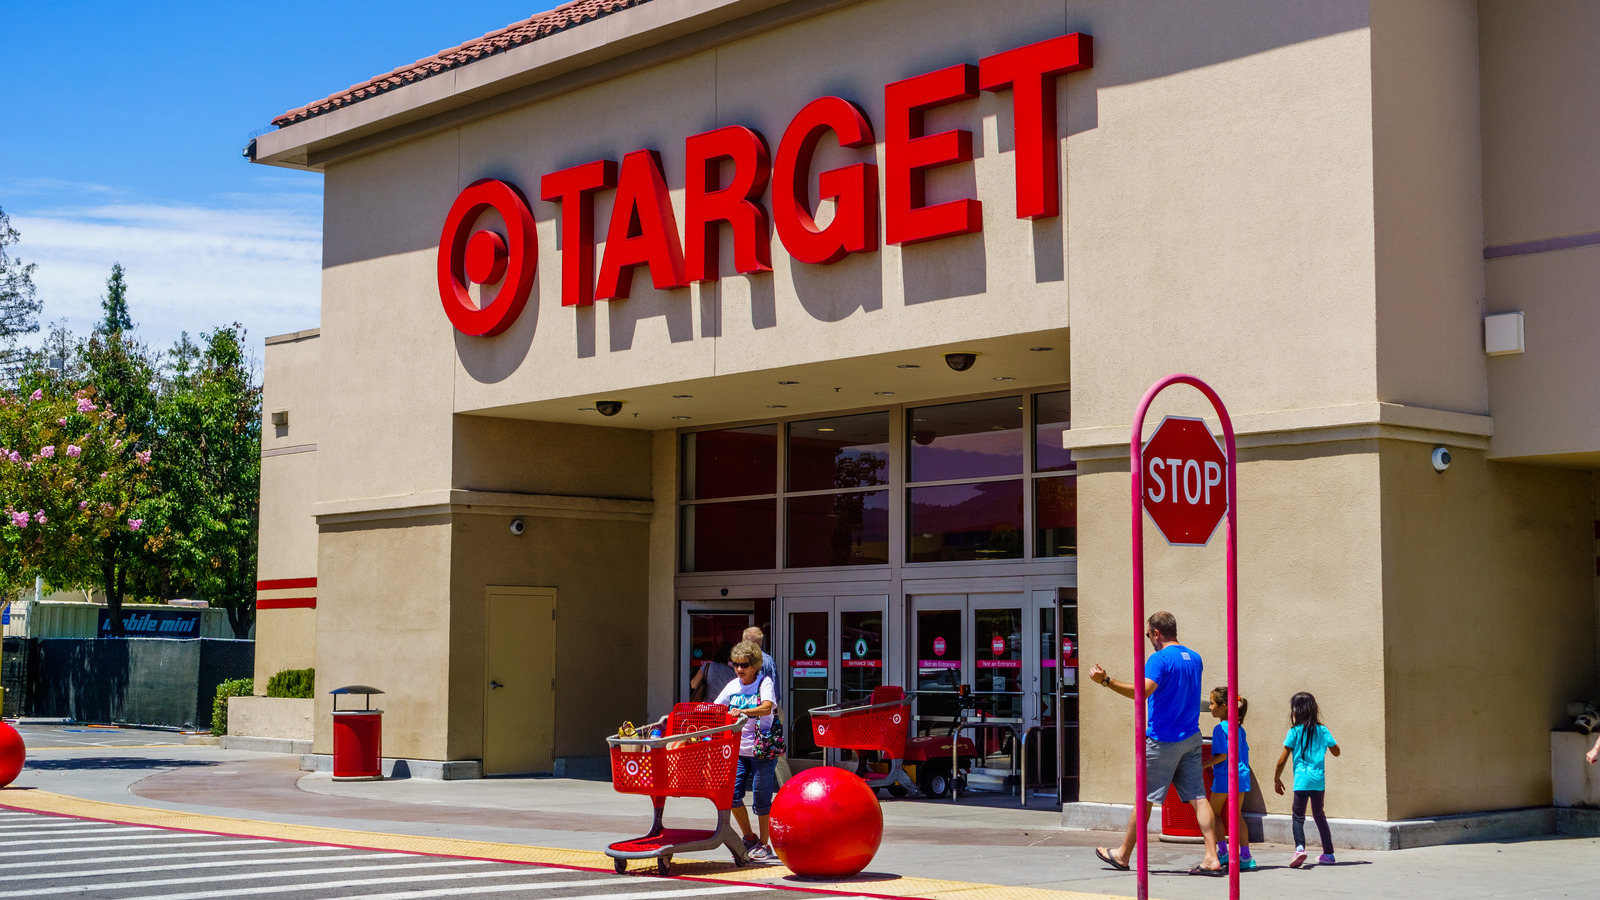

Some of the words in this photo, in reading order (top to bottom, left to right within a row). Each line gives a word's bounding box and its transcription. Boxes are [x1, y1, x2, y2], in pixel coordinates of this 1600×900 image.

[540, 31, 1093, 307] TARGET
[1148, 457, 1222, 505] STOP
[159, 617, 196, 632] mini
